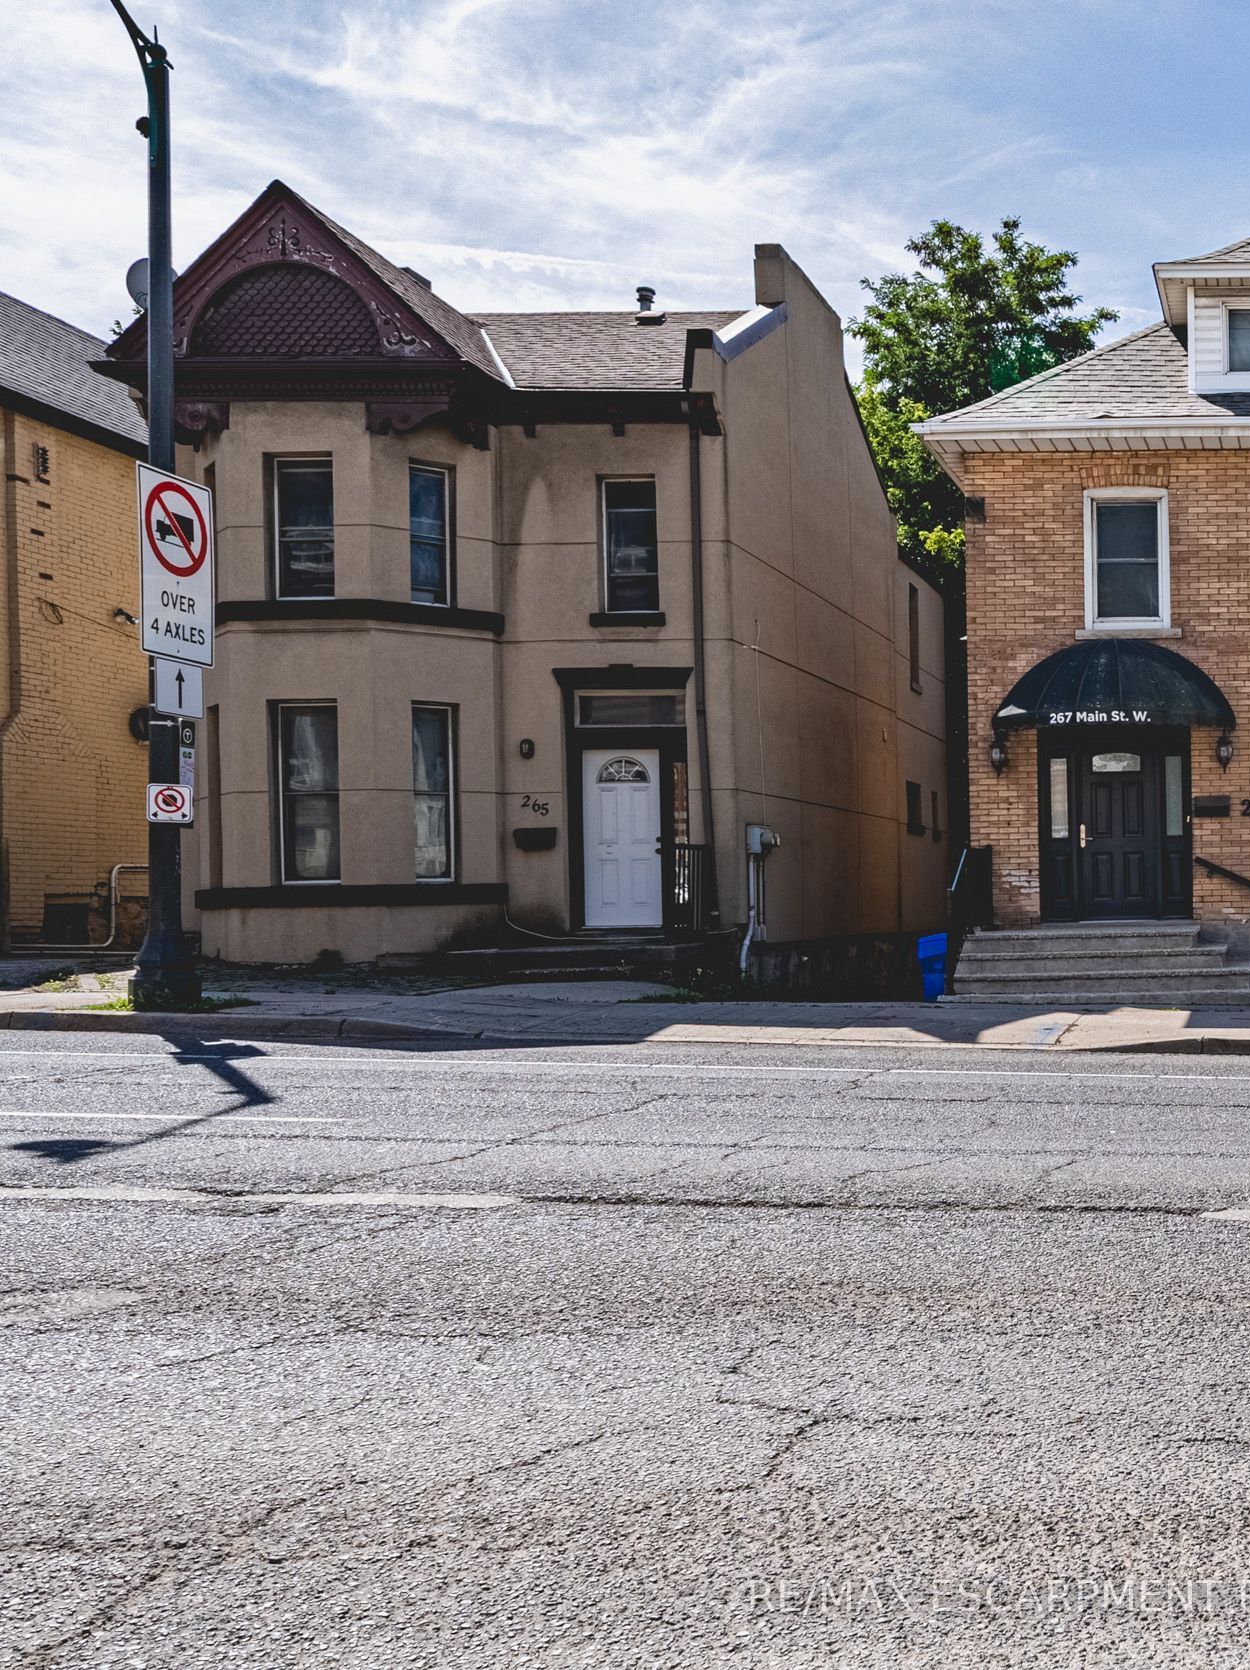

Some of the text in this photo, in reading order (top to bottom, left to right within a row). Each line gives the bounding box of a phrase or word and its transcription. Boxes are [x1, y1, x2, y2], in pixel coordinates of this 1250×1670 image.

[161, 590, 196, 615] OVER
[150, 617, 206, 646] 4 AXLES
[1049, 710, 1151, 724] 267 Main St. W.
[520, 794, 550, 817] 265
